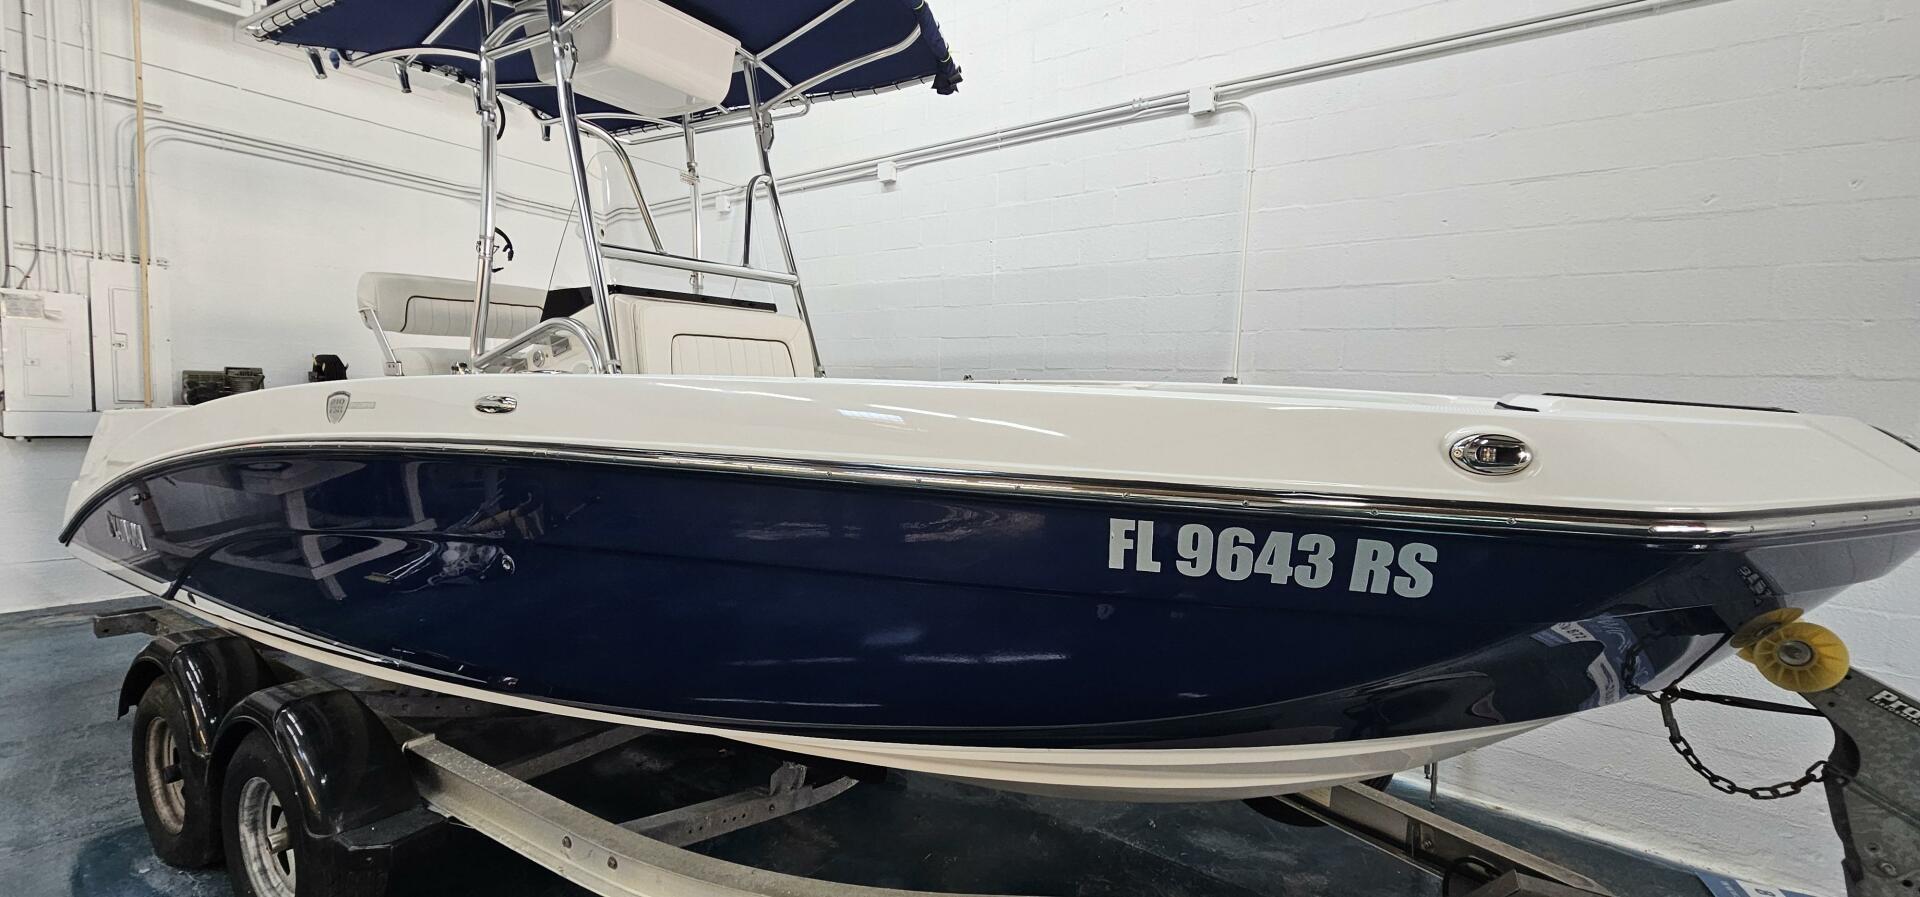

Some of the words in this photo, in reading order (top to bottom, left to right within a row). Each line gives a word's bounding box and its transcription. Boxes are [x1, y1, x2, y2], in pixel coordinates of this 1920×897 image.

[1108, 518, 1161, 572] FL
[1176, 523, 1336, 589] 9643
[1349, 538, 1438, 598] RS
